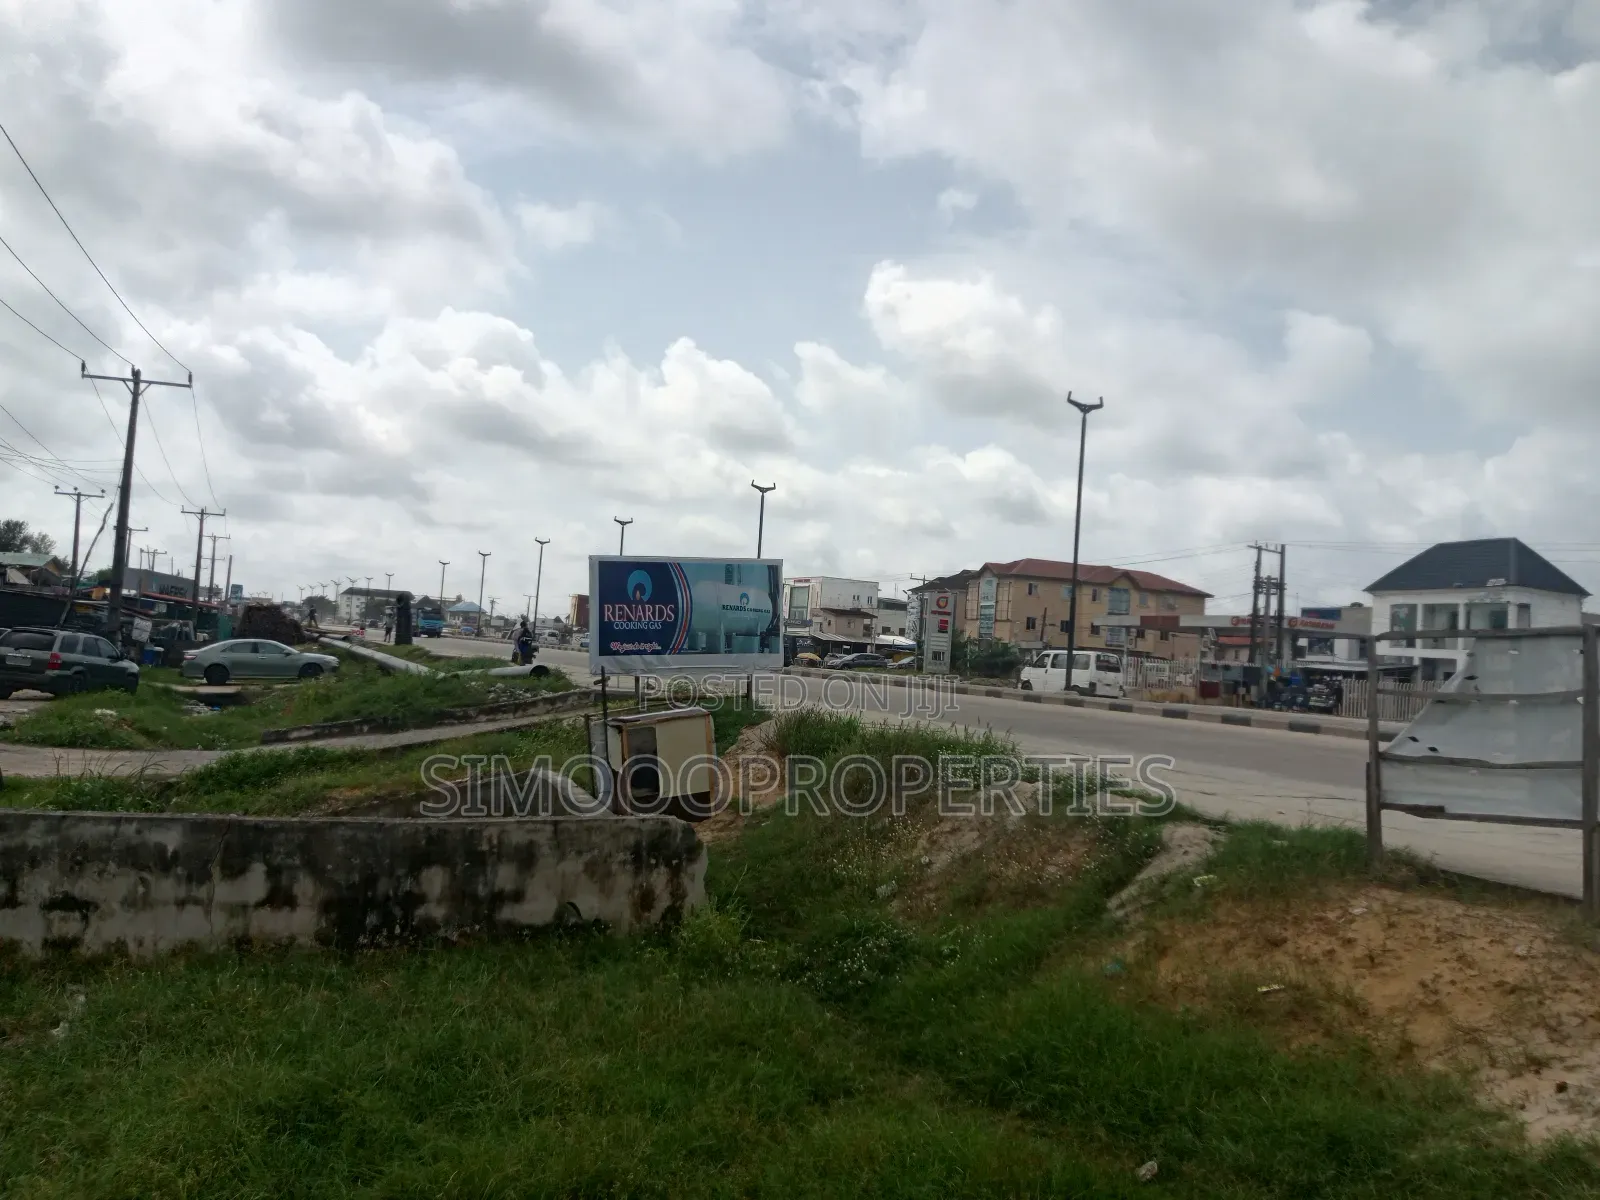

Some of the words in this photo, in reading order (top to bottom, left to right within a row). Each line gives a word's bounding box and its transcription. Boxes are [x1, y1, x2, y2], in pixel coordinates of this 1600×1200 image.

[722, 604, 746, 612] RENARDS
[604, 604, 675, 622] RENARDS
[613, 621, 648, 630] COOKING
[648, 621, 662, 630] GAS
